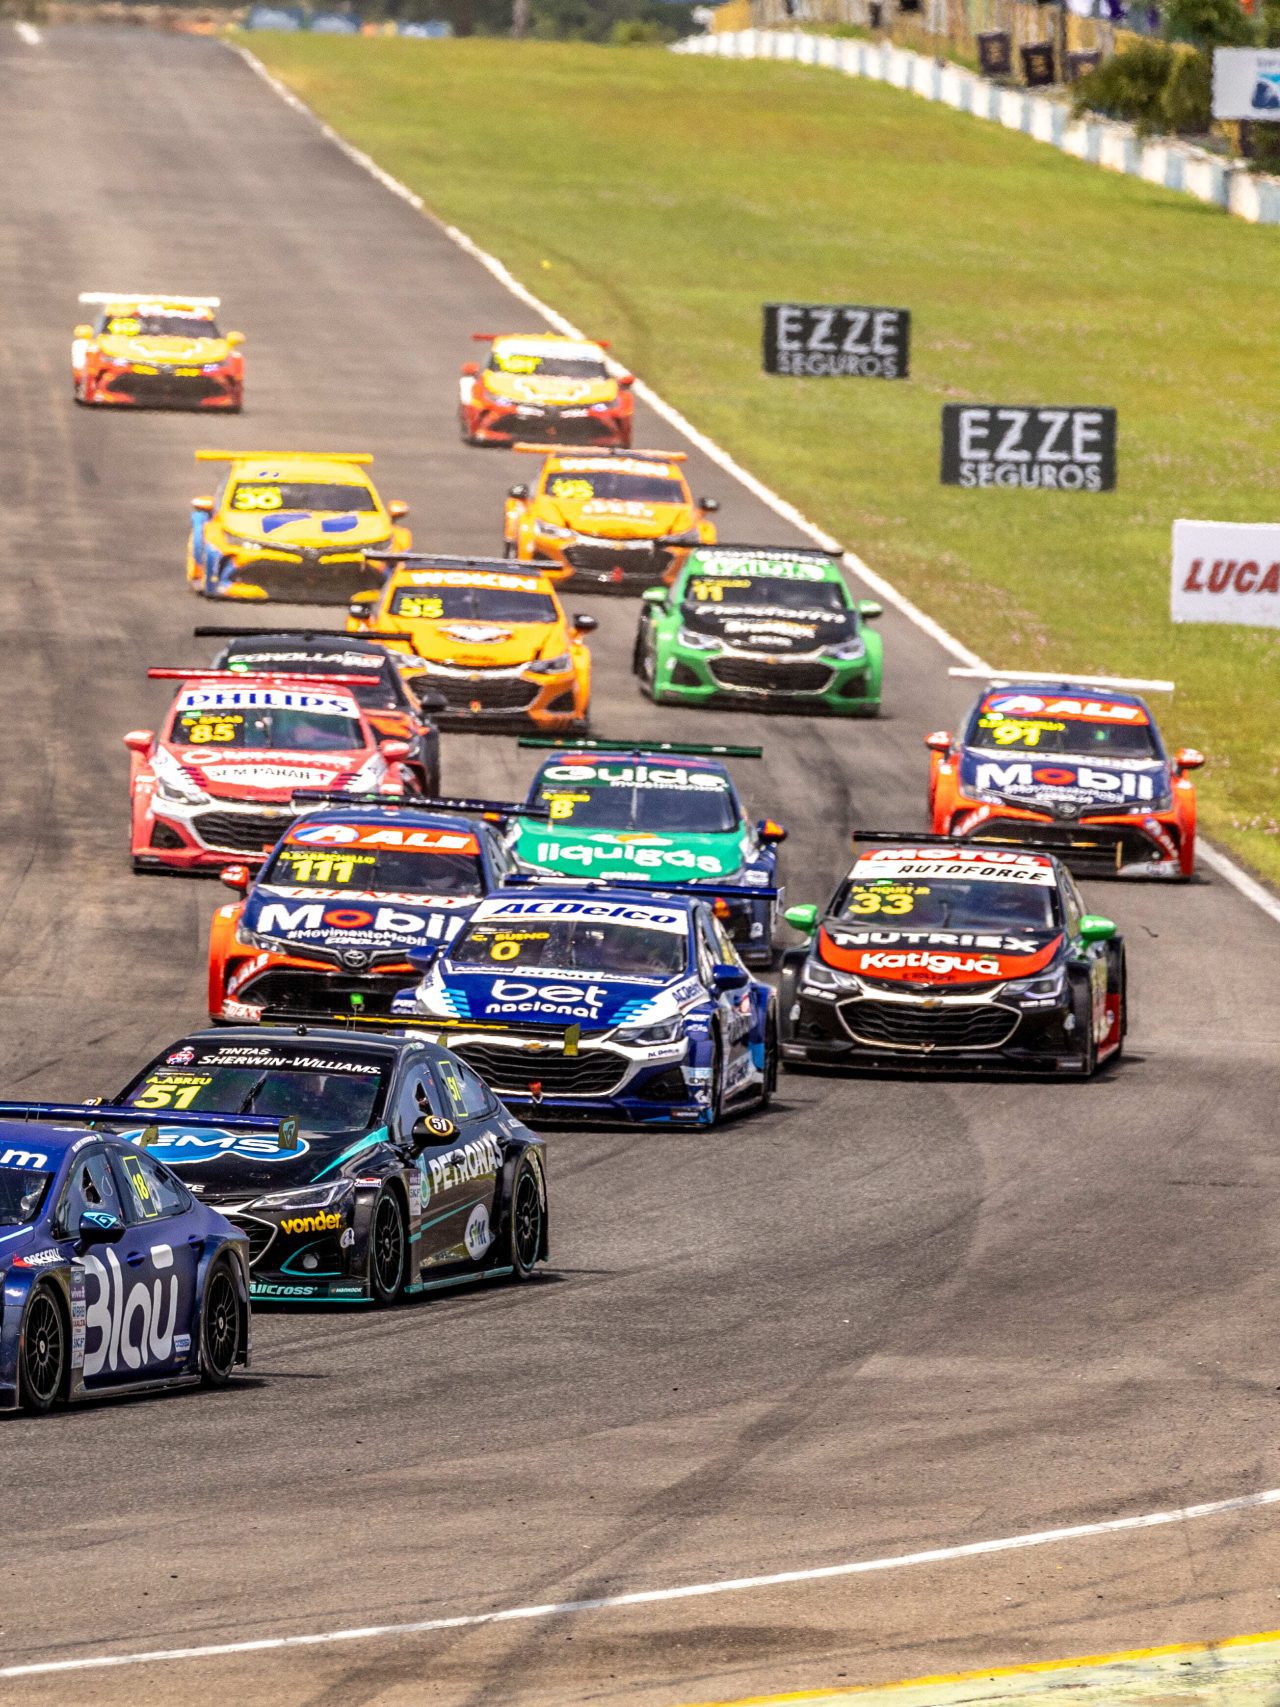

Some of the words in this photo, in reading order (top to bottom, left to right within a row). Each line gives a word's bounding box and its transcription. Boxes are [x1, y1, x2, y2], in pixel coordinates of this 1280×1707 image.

[776, 308, 900, 355] EZZE
[777, 352, 899, 378] SEGUROS
[959, 409, 1103, 462] EZZE
[959, 463, 1102, 490] SEGUROS
[187, 692, 350, 713] PHILIPS
[189, 724, 235, 743] 85
[976, 763, 1153, 800] Mobil
[360, 830, 472, 849] ALE
[871, 849, 1042, 866] MOTUL
[292, 859, 354, 883] 111
[898, 865, 1048, 881] AUTOFORCE
[492, 902, 678, 925] ACDelco
[848, 893, 915, 915] 33
[257, 904, 466, 942] Mobil
[833, 932, 1039, 954] NUTRIEX
[490, 979, 608, 1008] bet
[485, 1001, 600, 1020] nacional
[218, 1047, 272, 1056] TINTAS
[145, 1076, 213, 1086] A.ABREU
[132, 1084, 203, 1110] 51
[431, 1117, 448, 1132] 51
[428, 1134, 504, 1195] PETRONAS
[132, 1173, 150, 1200] 18
[280, 1210, 342, 1235] vonder
